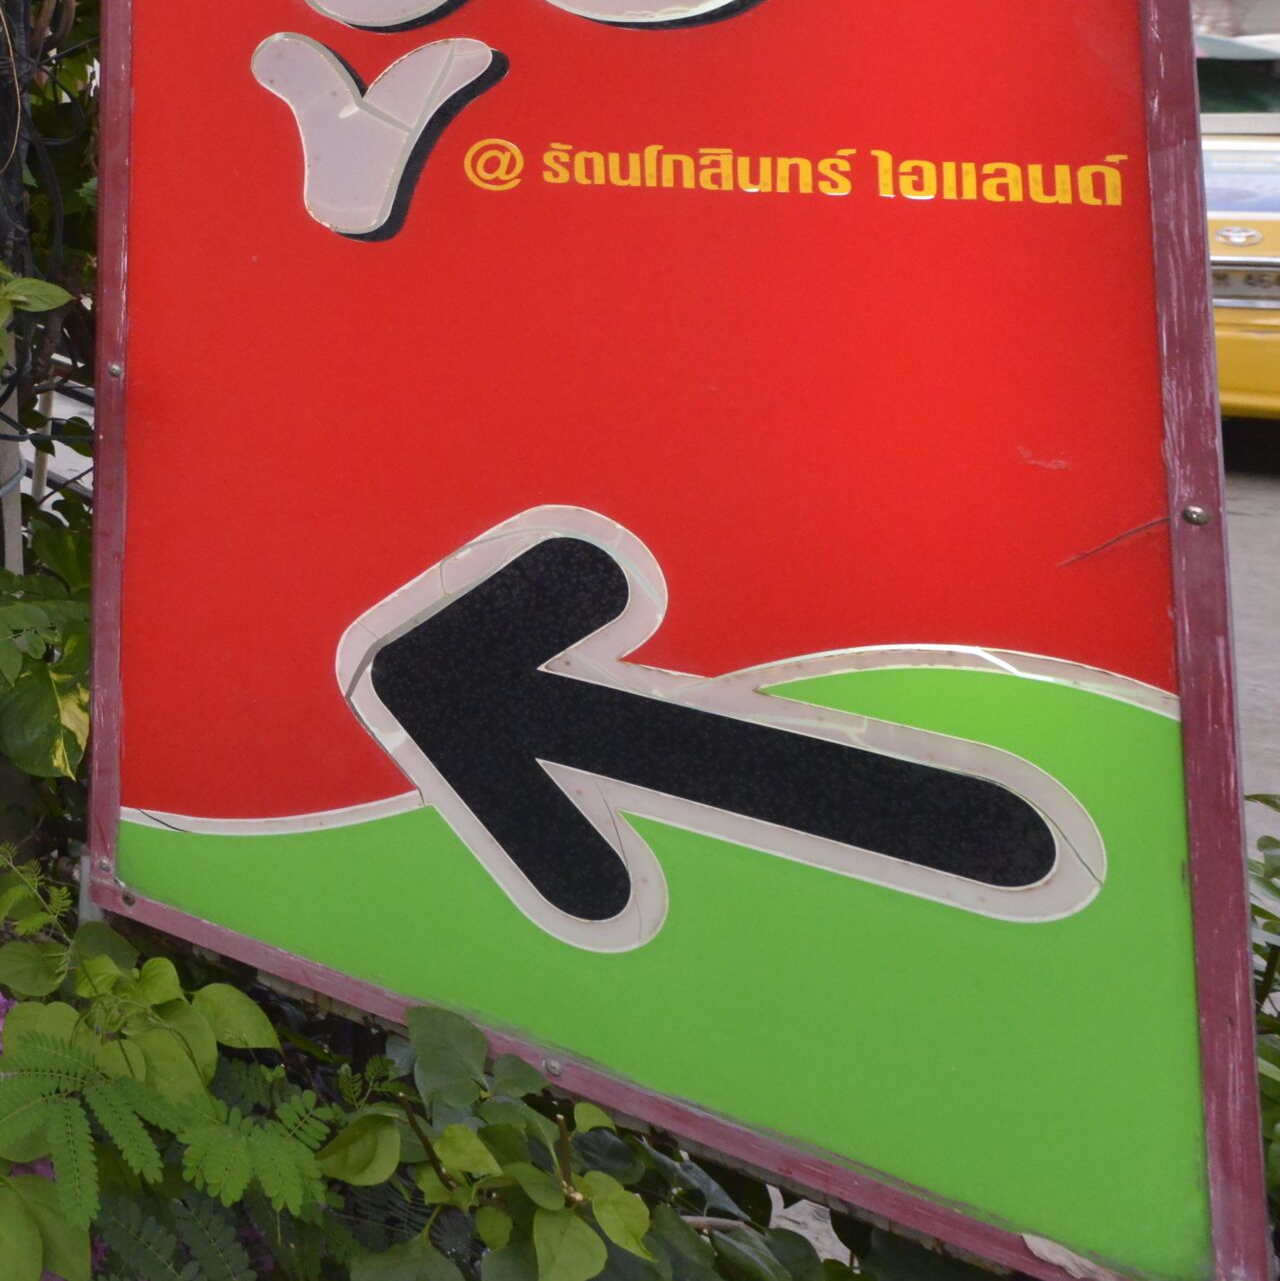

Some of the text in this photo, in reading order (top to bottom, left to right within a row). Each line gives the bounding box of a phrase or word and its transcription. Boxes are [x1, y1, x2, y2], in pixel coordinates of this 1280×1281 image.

[463, 138, 1128, 206] @ รัตนโกสินทร์ ไอแลนด์
